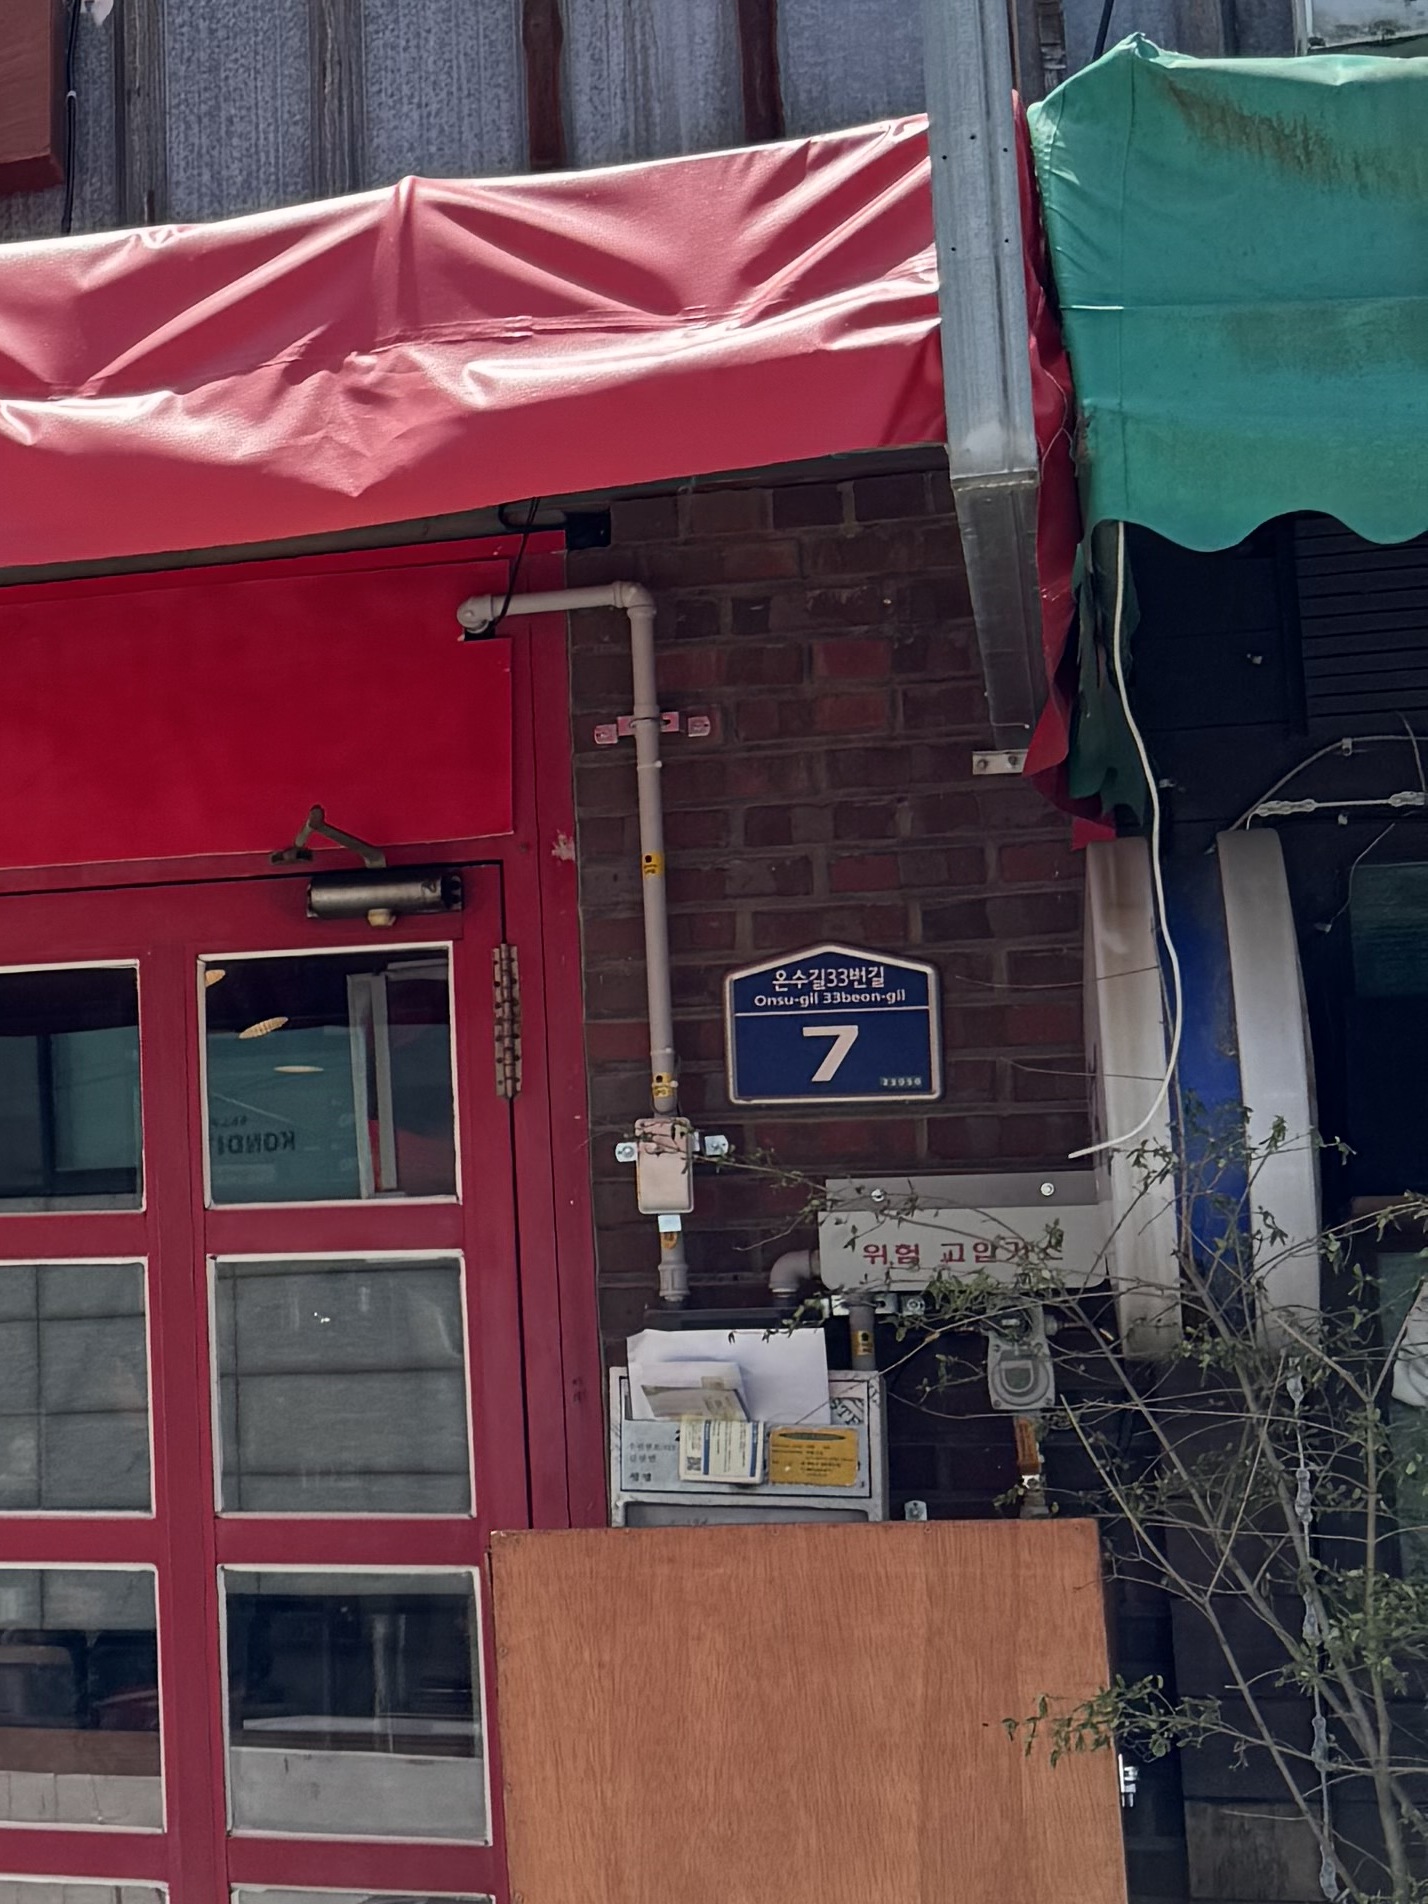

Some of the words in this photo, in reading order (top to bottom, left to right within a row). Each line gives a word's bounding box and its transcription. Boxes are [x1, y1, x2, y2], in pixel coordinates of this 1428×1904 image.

[772, 965, 885, 992] 온수길33번길
[754, 992, 819, 1008] Onsu-gil
[822, 988, 906, 1005] 33beon-gil
[802, 1025, 859, 1083] 7
[863, 1243, 920, 1265] 위험
